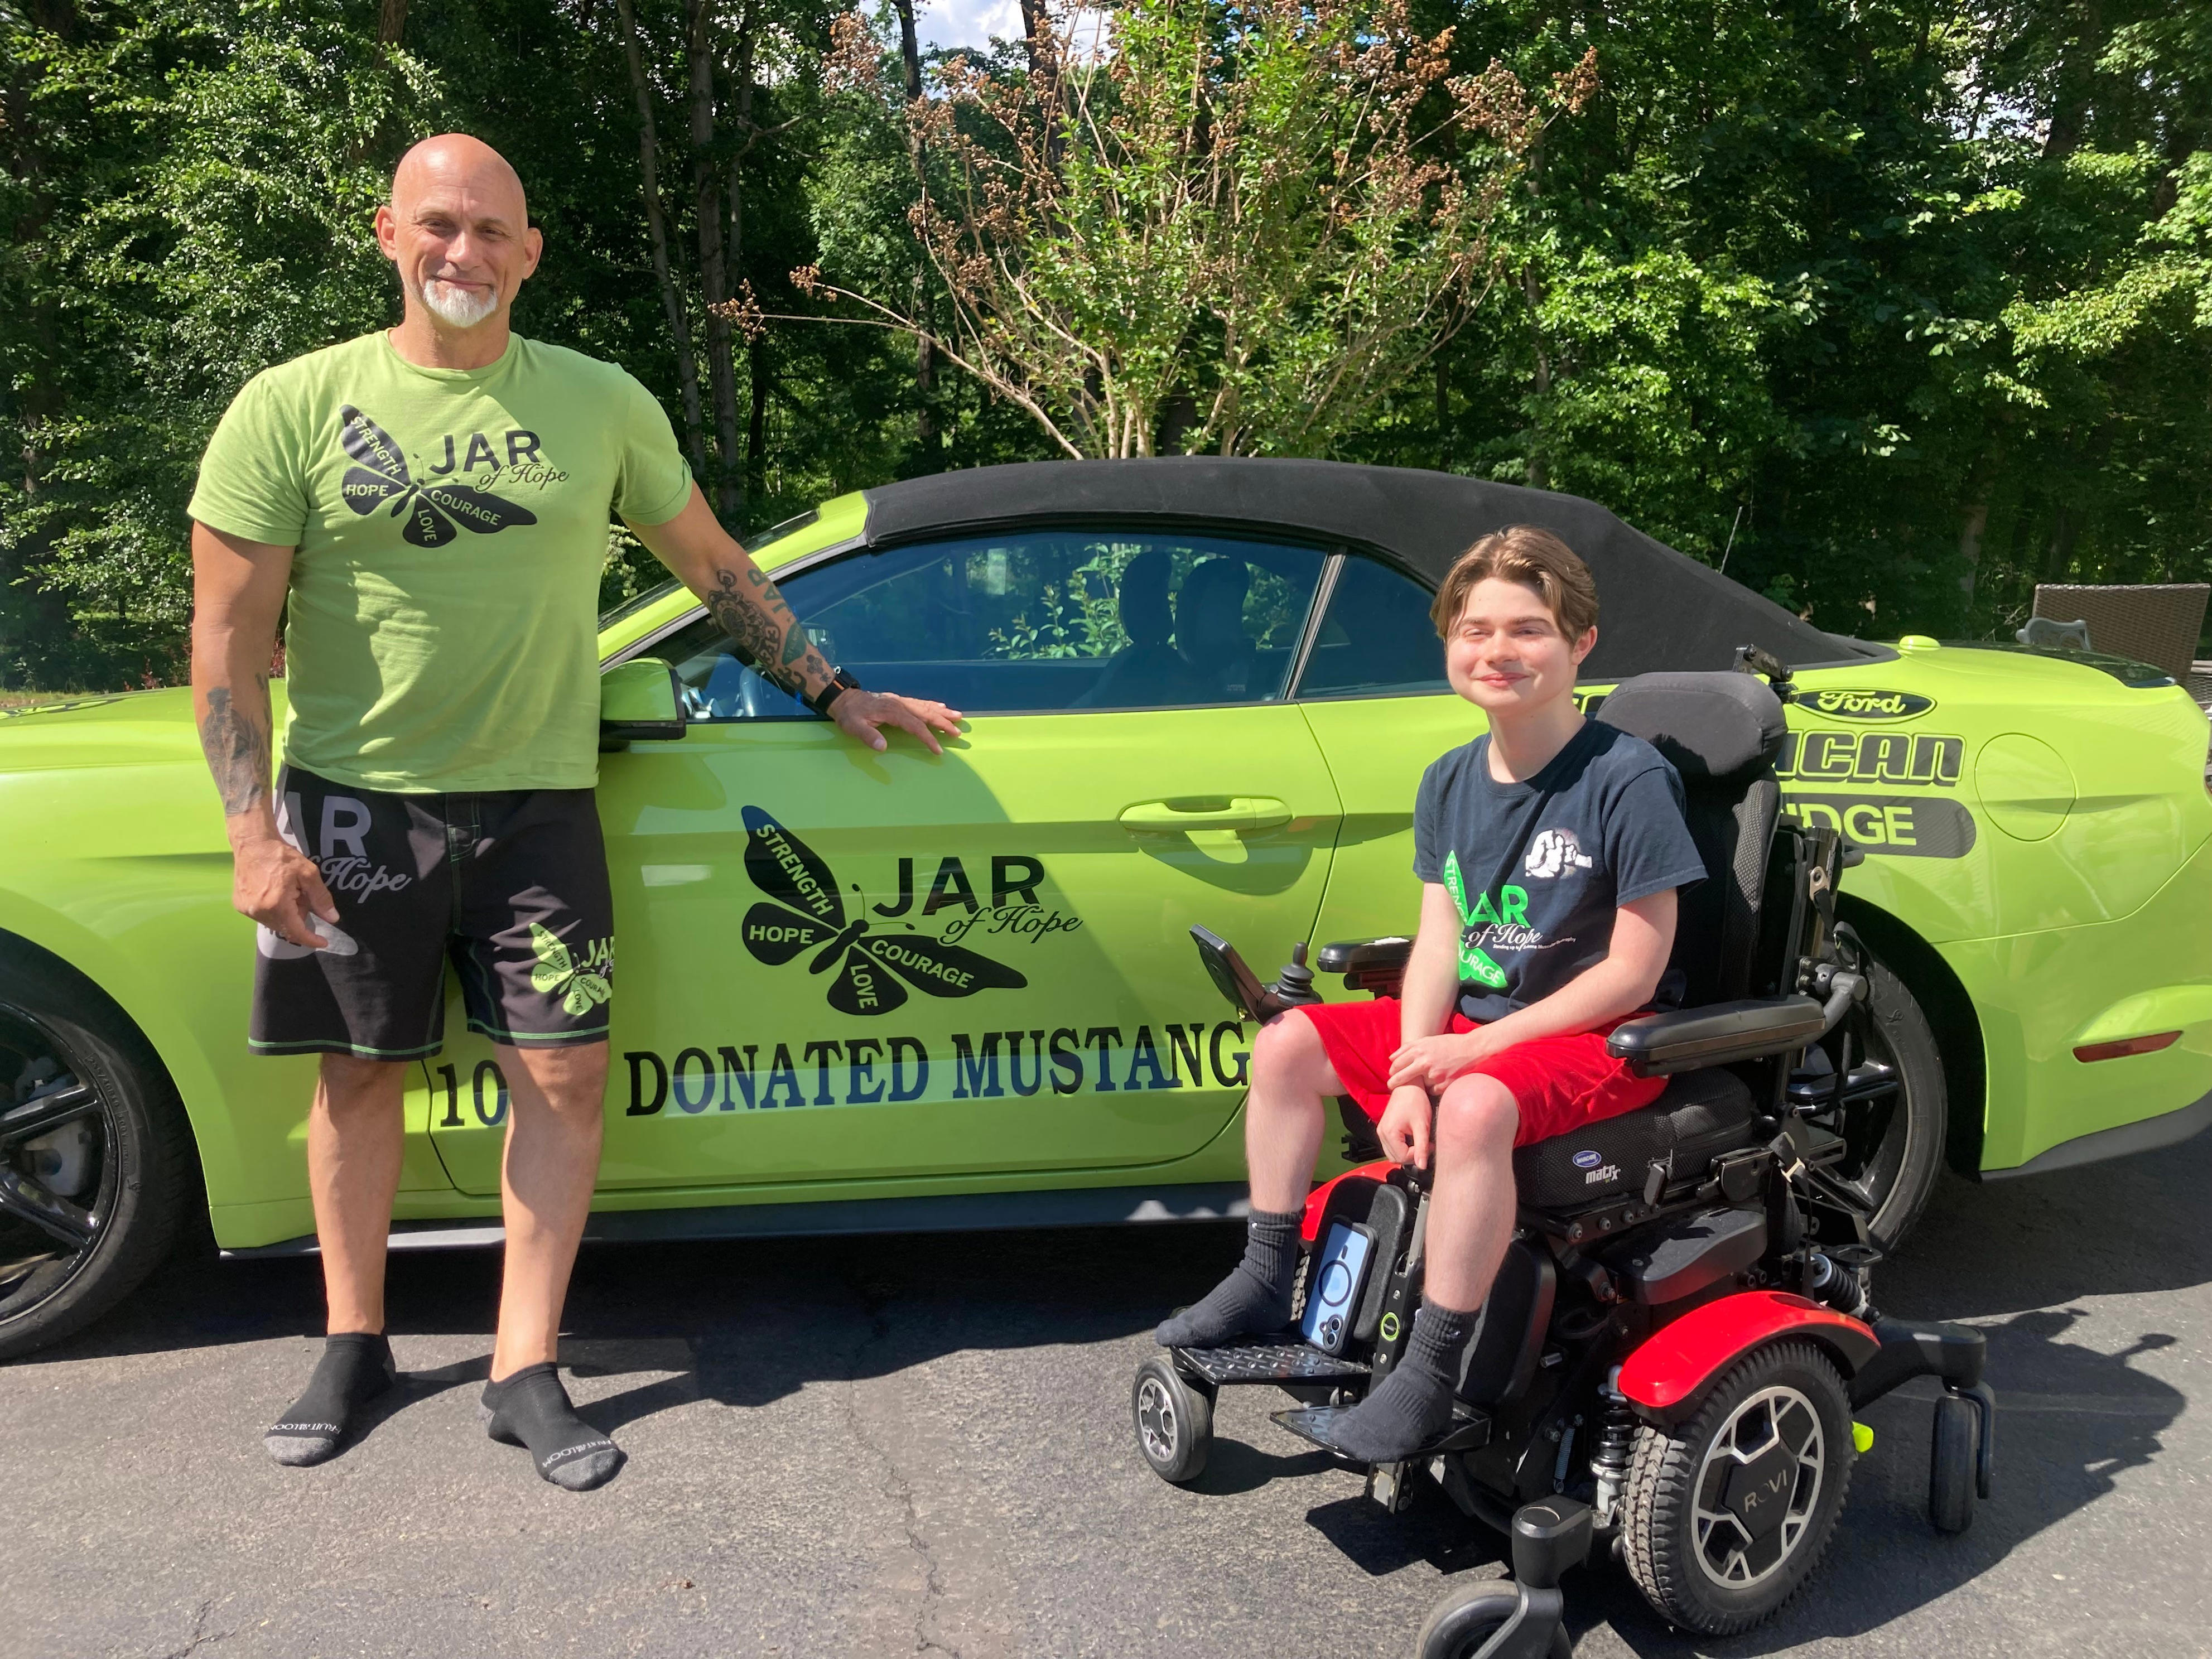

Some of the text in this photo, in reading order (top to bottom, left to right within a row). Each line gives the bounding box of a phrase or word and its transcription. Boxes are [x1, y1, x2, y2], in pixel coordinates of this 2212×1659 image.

[351, 416, 402, 475] STRENGTH
[428, 430, 541, 475] JAR
[346, 484, 389, 497] HOPE
[474, 462, 570, 492] of Hope
[417, 509, 437, 542] LOVE
[430, 489, 502, 526] COURAGE
[1817, 691, 1906, 714] Ford
[1774, 729, 1967, 787] ICAN
[273, 789, 372, 861] AR
[1780, 803, 1917, 846] DGE
[321, 856, 412, 904] Hope
[756, 823, 835, 916] STRENGTH
[872, 856, 1045, 918] JAR
[1446, 858, 1468, 924] STRENG
[1466, 885, 1531, 928] AR
[749, 925, 815, 944] HOPE
[940, 904, 1083, 946] of Hope
[1464, 923, 1498, 949] of
[1492, 922, 1543, 951] Hope
[539, 930, 567, 968] STRENGTH
[871, 940, 975, 990] COURAGE
[1458, 950, 1503, 985] URAGE
[534, 973, 561, 982] HOPE
[850, 964, 879, 1010] LOVE
[575, 988, 584, 1011] LOVE
[437, 1021, 1251, 1127] 10 DONATED MUSTANG
[542, 1448, 577, 1468] LOOM
